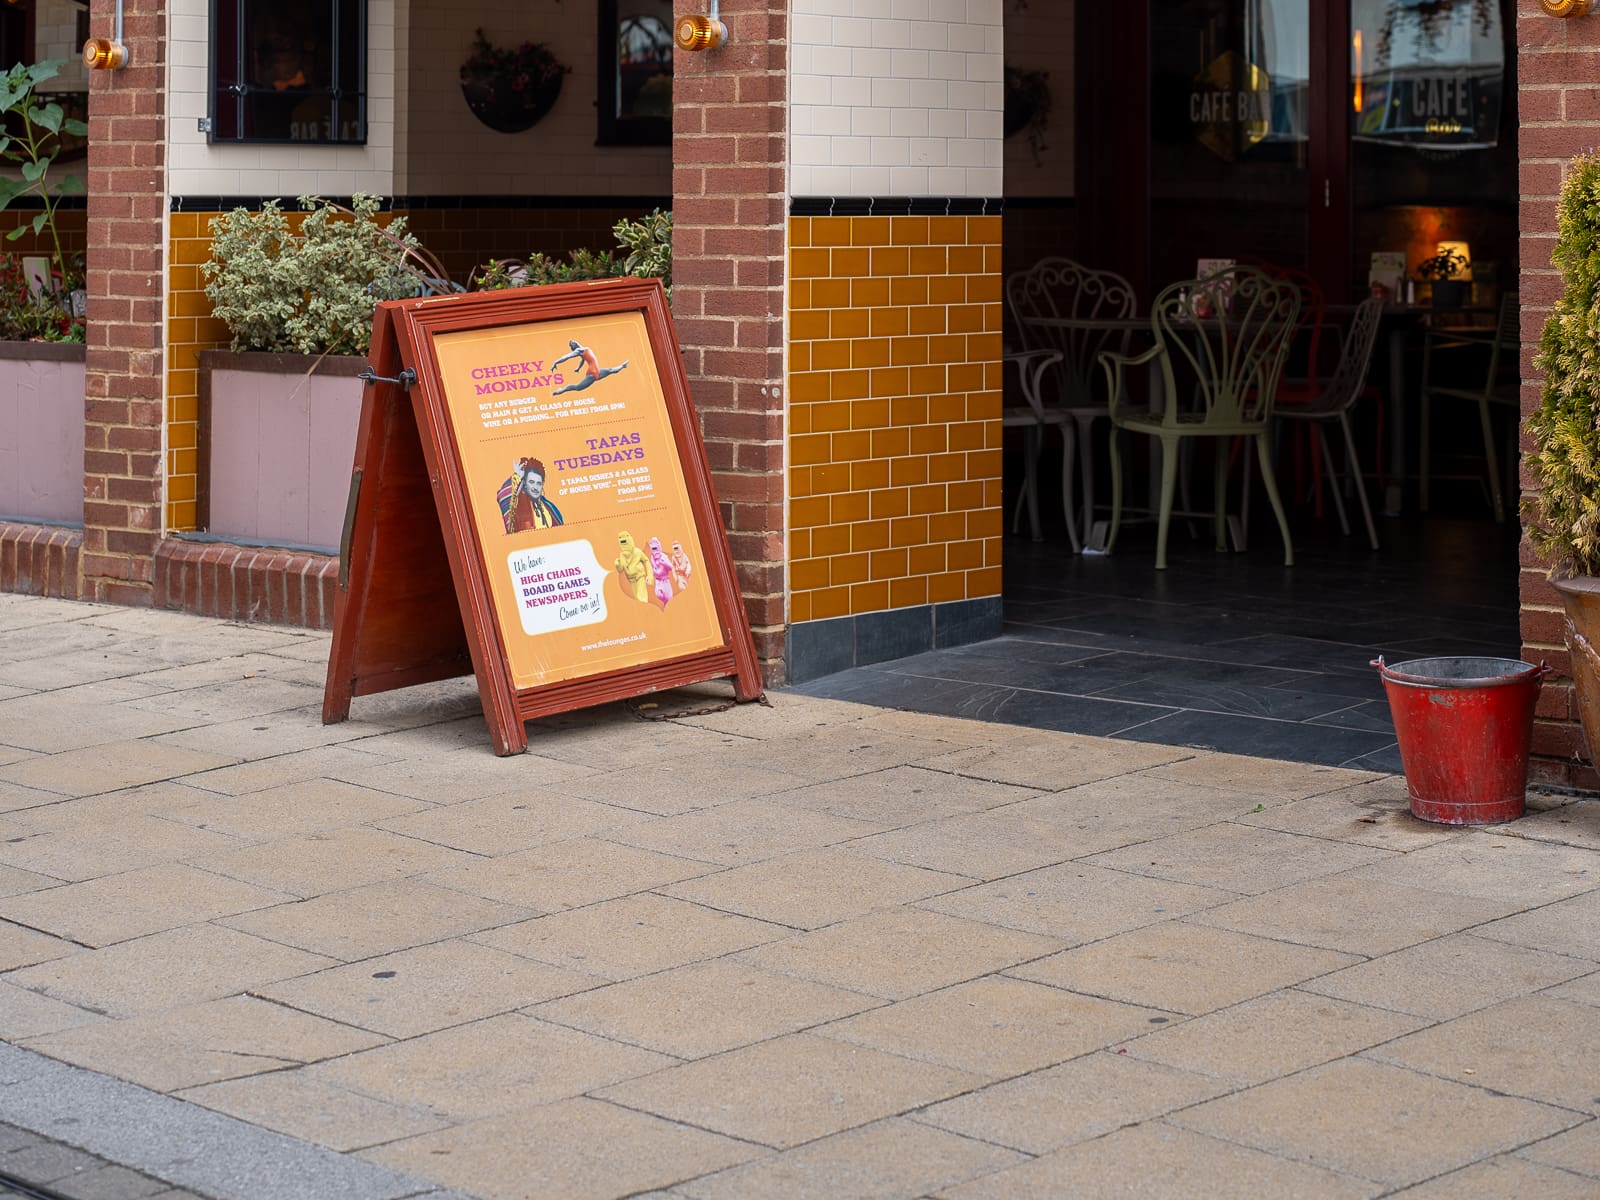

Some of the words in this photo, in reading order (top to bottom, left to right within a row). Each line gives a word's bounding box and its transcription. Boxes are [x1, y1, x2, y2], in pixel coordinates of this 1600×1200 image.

[472, 361, 544, 380] CHEEKY
[475, 374, 564, 395] MONDAYS
[479, 403, 493, 411] BUY
[495, 400, 509, 409] ANY
[481, 412, 491, 420] OR
[493, 409, 511, 418] MAIN
[519, 406, 533, 415] GET
[540, 402, 563, 411] GLASS
[563, 400, 573, 408] OF
[574, 398, 596, 406] HOUSE
[483, 420, 502, 429] WINE
[503, 418, 513, 426] OR
[556, 410, 569, 419] FOR
[591, 405, 609, 414] FROM
[586, 433, 641, 451] TAPAS
[554, 448, 645, 471] TUESDAYS
[567, 476, 589, 485] TAPAS
[590, 472, 614, 482] DISHES
[627, 466, 649, 475] GLASS
[570, 485, 593, 494] HOUSE
[618, 478, 631, 487] FOR
[618, 487, 637, 496] FROM
[514, 561, 527, 574] We
[520, 573, 545, 586] HIGH
[547, 567, 582, 581] CHAIRS
[523, 583, 555, 597] BOARD
[558, 577, 591, 591] GAMES
[526, 590, 588, 609] NEWSPAPERS
[560, 607, 579, 621] Come
[580, 604, 589, 613] on
[581, 632, 647, 652] www.thelounges.co.uk
